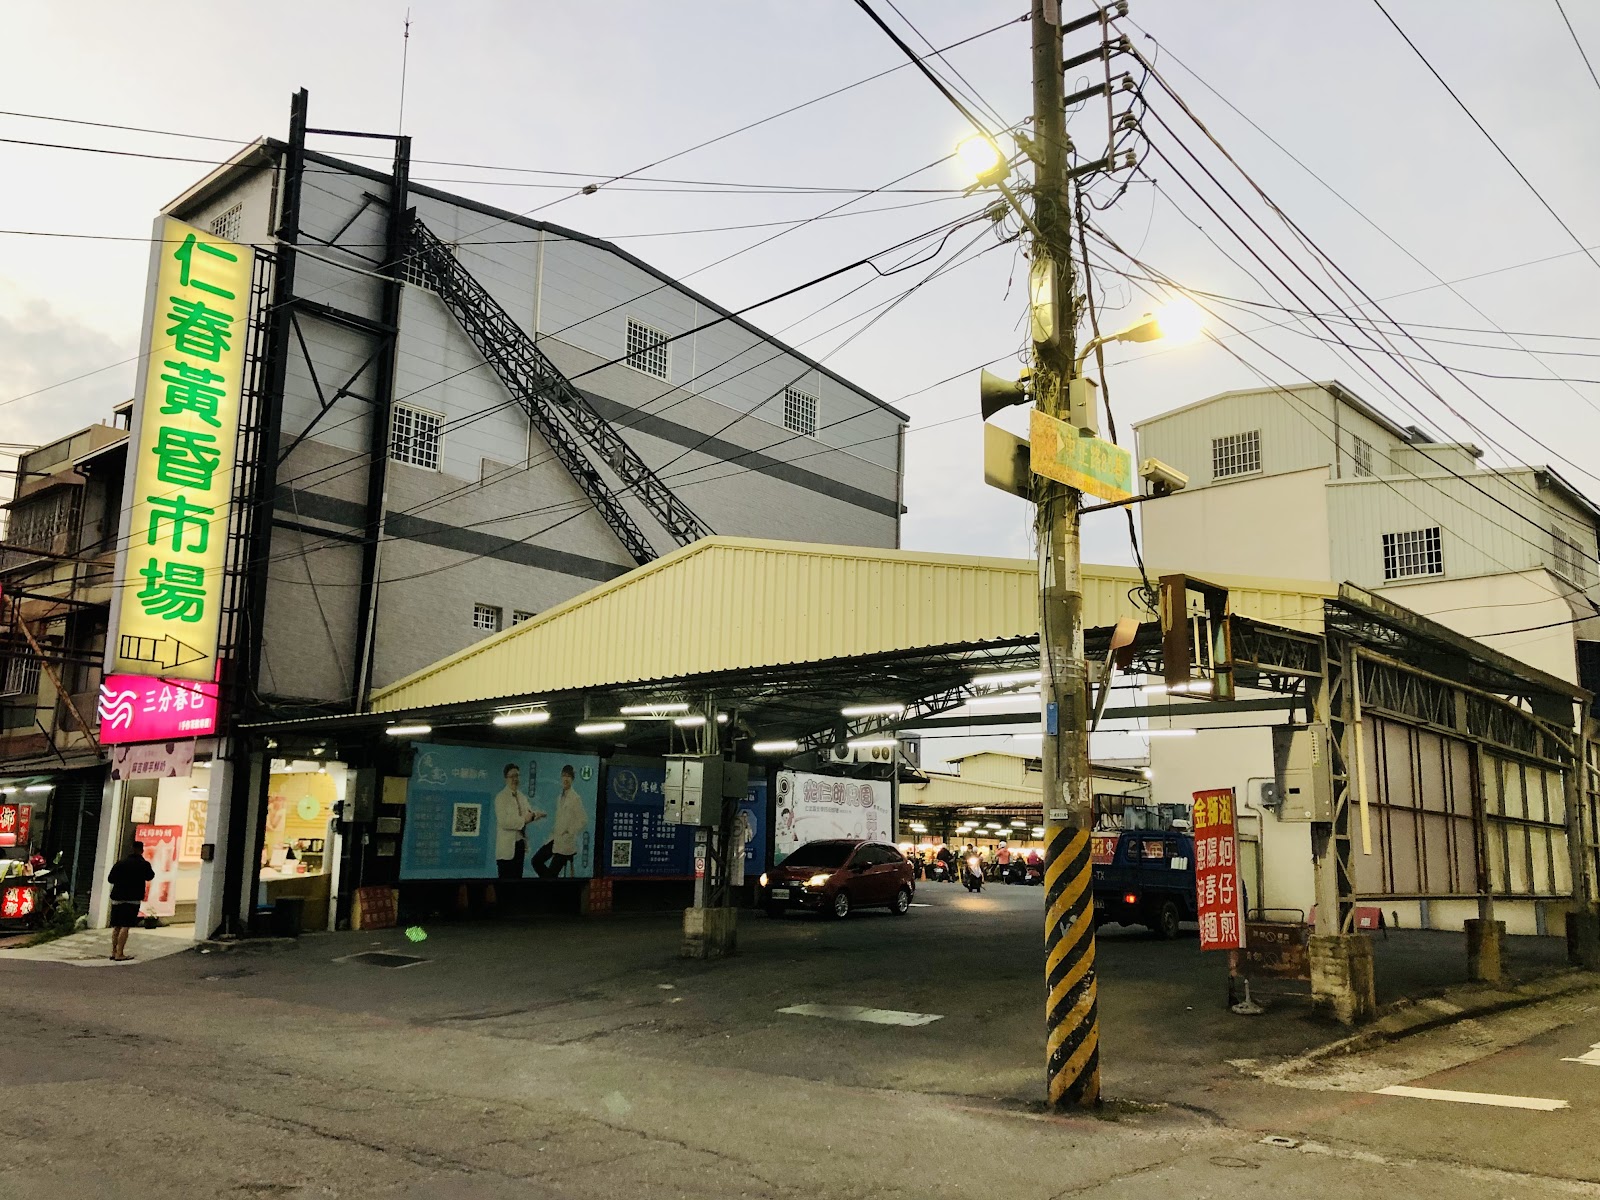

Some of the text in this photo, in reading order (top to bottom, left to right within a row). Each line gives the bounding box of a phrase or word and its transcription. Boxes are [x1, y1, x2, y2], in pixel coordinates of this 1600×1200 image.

[137, 233, 238, 623] 仁春黃昏市場
[143, 683, 204, 712] 三分春色
[1193, 794, 1232, 829] 金獅湖
[1204, 837, 1219, 943] 陽春麵
[1218, 836, 1237, 943] 蚵仔煎
